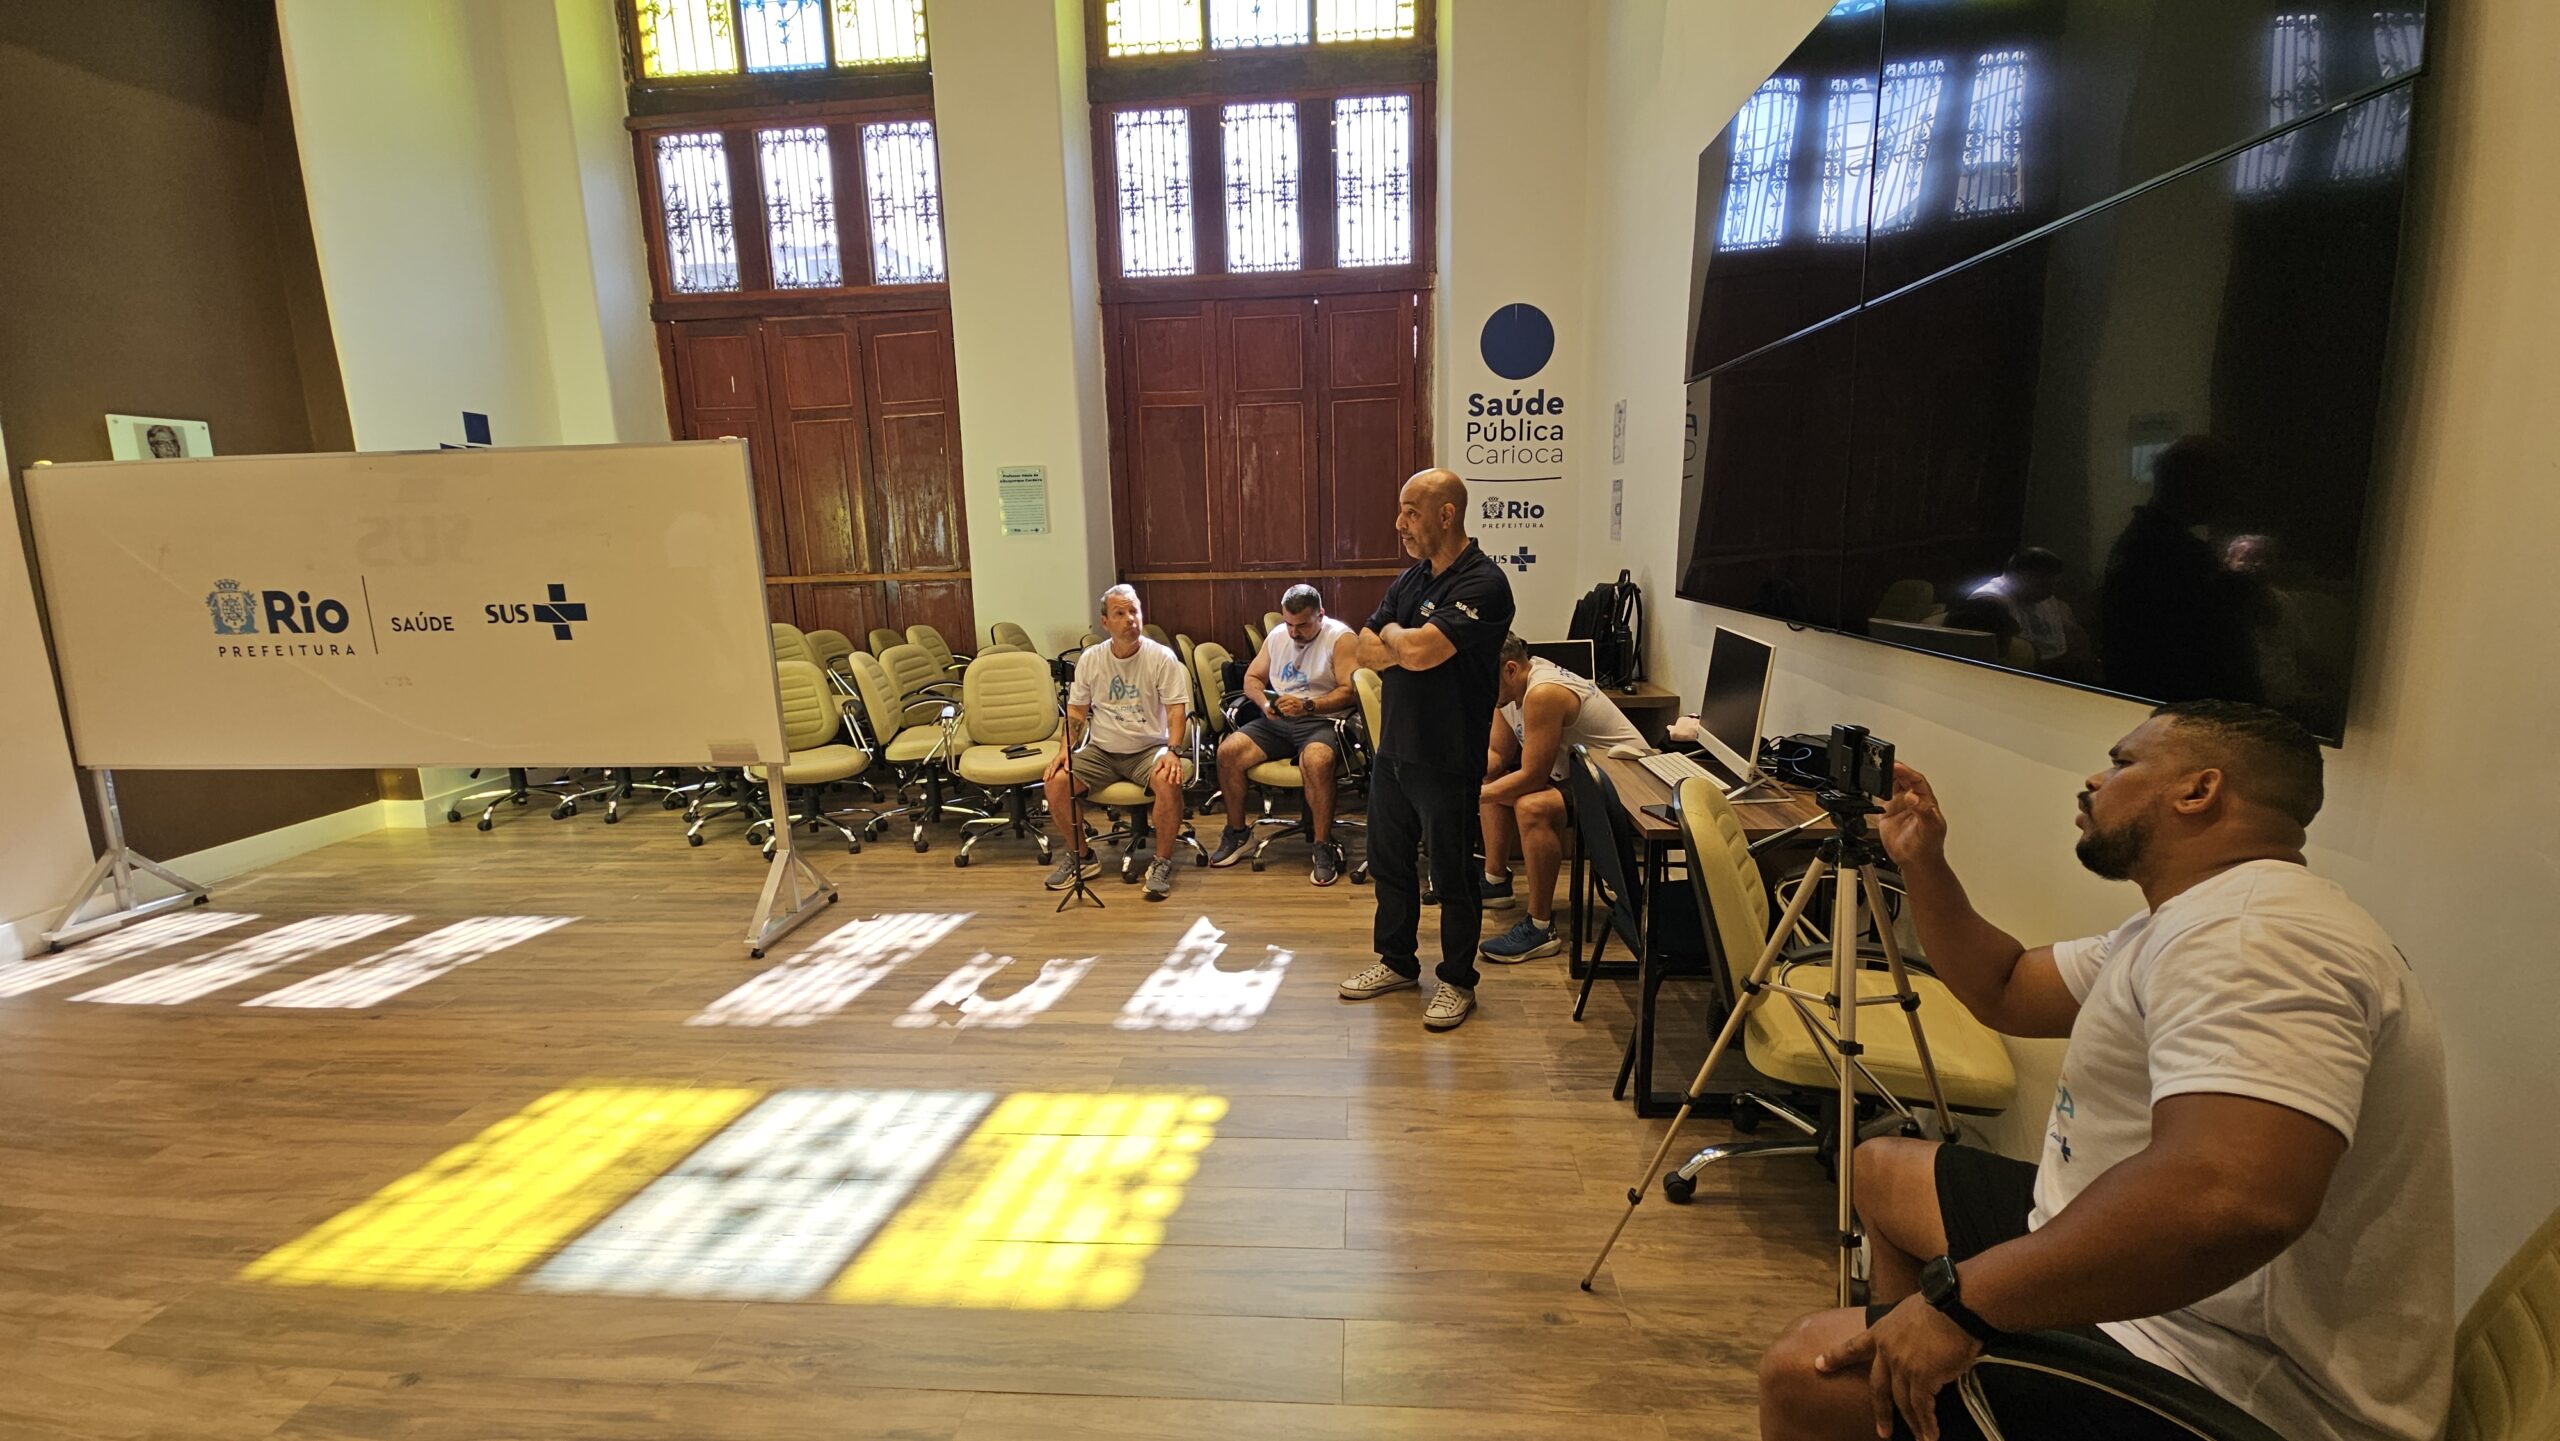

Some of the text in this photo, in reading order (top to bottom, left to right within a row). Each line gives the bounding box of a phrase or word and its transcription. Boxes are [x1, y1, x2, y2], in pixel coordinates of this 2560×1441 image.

[1468, 389, 1564, 416] Saúde
[1466, 418, 1564, 442] Pública
[1466, 444, 1564, 465] Carioca
[1507, 501, 1545, 519] Rio
[262, 590, 349, 634] Rio
[391, 611, 455, 632] SAÚDE
[485, 603, 530, 623] SUS
[219, 643, 356, 657] PREFEITURA
